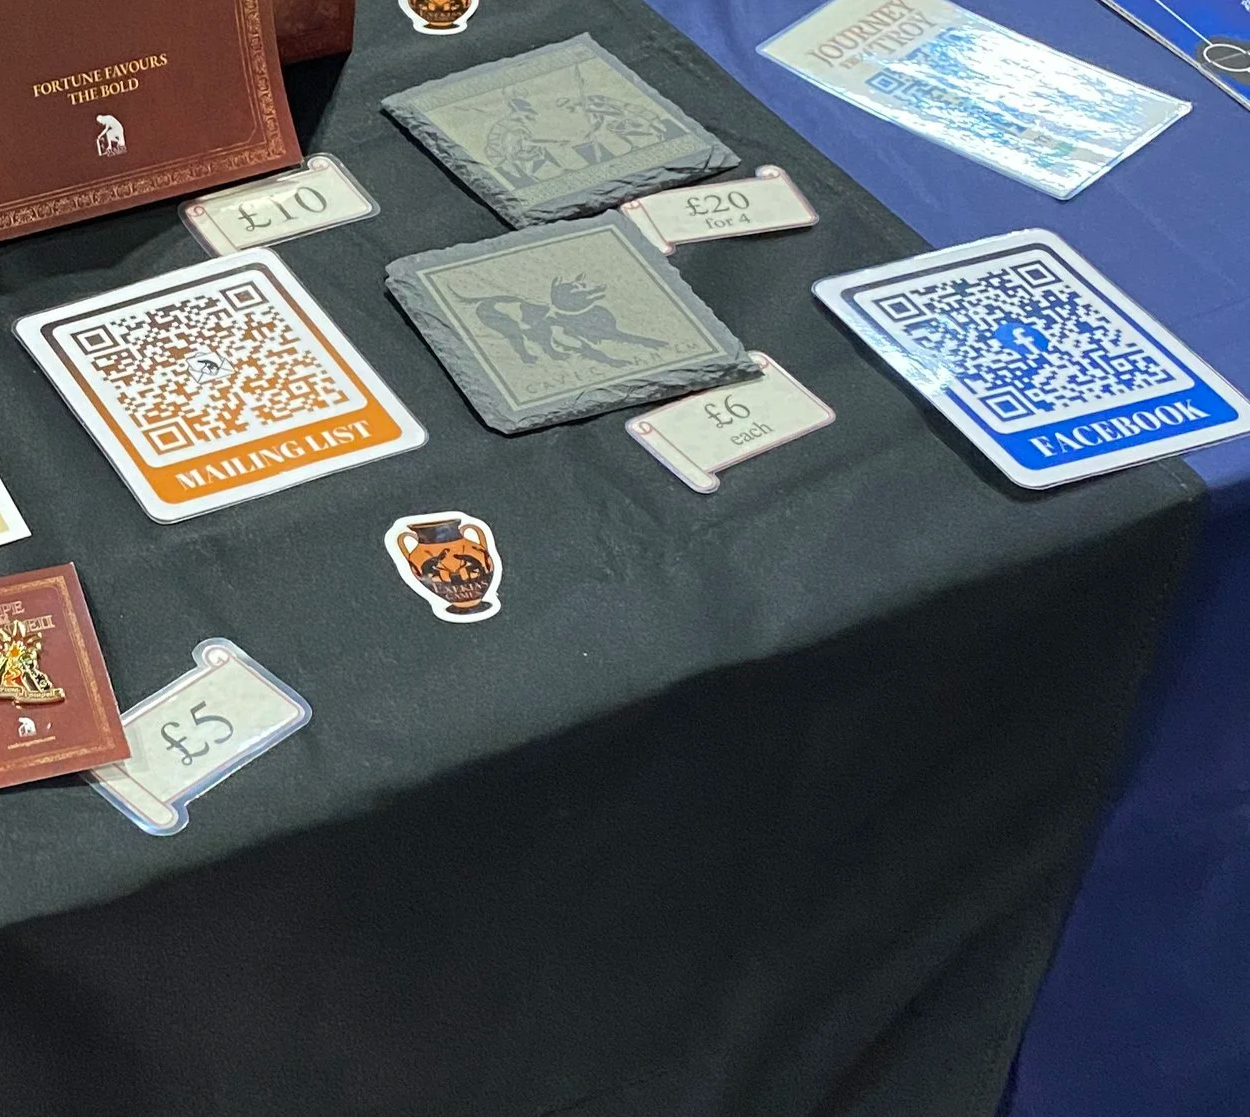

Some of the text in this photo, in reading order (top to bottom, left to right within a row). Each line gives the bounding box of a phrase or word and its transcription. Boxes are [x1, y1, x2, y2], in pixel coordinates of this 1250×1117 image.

[868, 10, 938, 55] TROY
[32, 52, 168, 98] FORTUNE FAVOURS
[67, 77, 140, 106] THE BOLD
[237, 185, 328, 233] £10
[685, 190, 750, 216] £20
[705, 212, 751, 231] for 4
[703, 397, 751, 429] £6
[729, 419, 774, 448] each
[1029, 398, 1211, 458] FACEBOOK
[174, 419, 373, 492] MAILING LIST
[159, 700, 236, 768] £5
